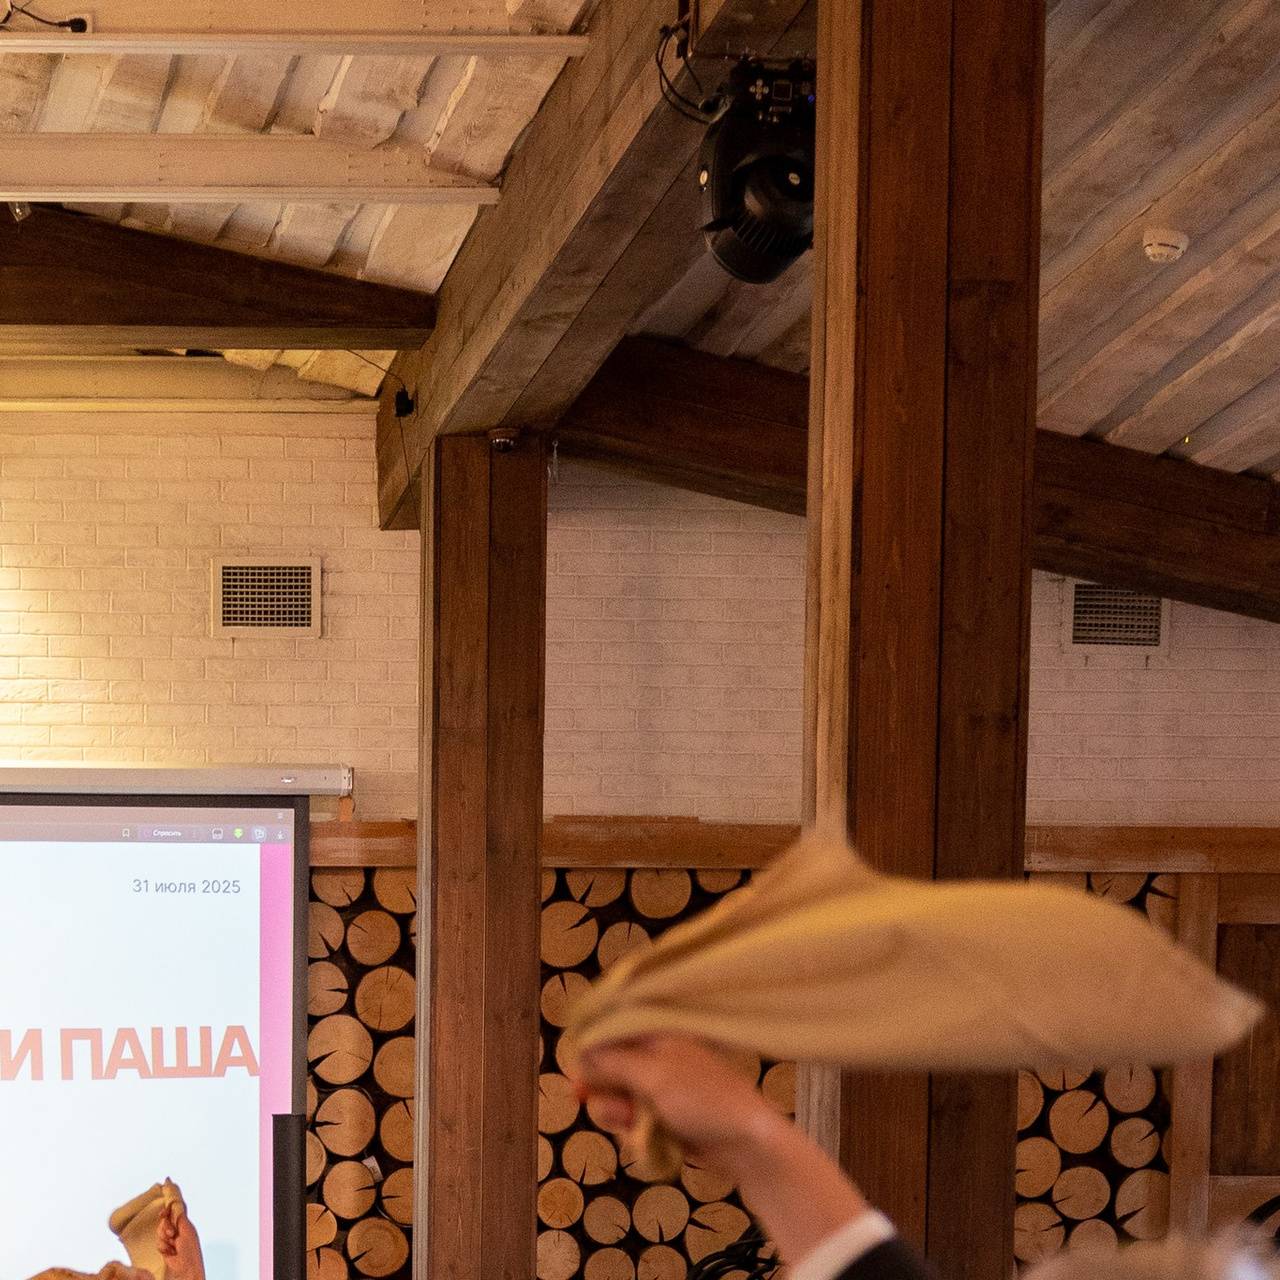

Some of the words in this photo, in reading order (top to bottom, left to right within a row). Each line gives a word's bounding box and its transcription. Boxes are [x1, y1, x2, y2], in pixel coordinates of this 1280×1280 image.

[153, 829, 182, 838] Спросить
[132, 879, 149, 893] 31
[155, 881, 196, 893] июля
[202, 879, 241, 894] 2025
[0, 1028, 44, 1081] И
[60, 1025, 261, 1081] ПАША
